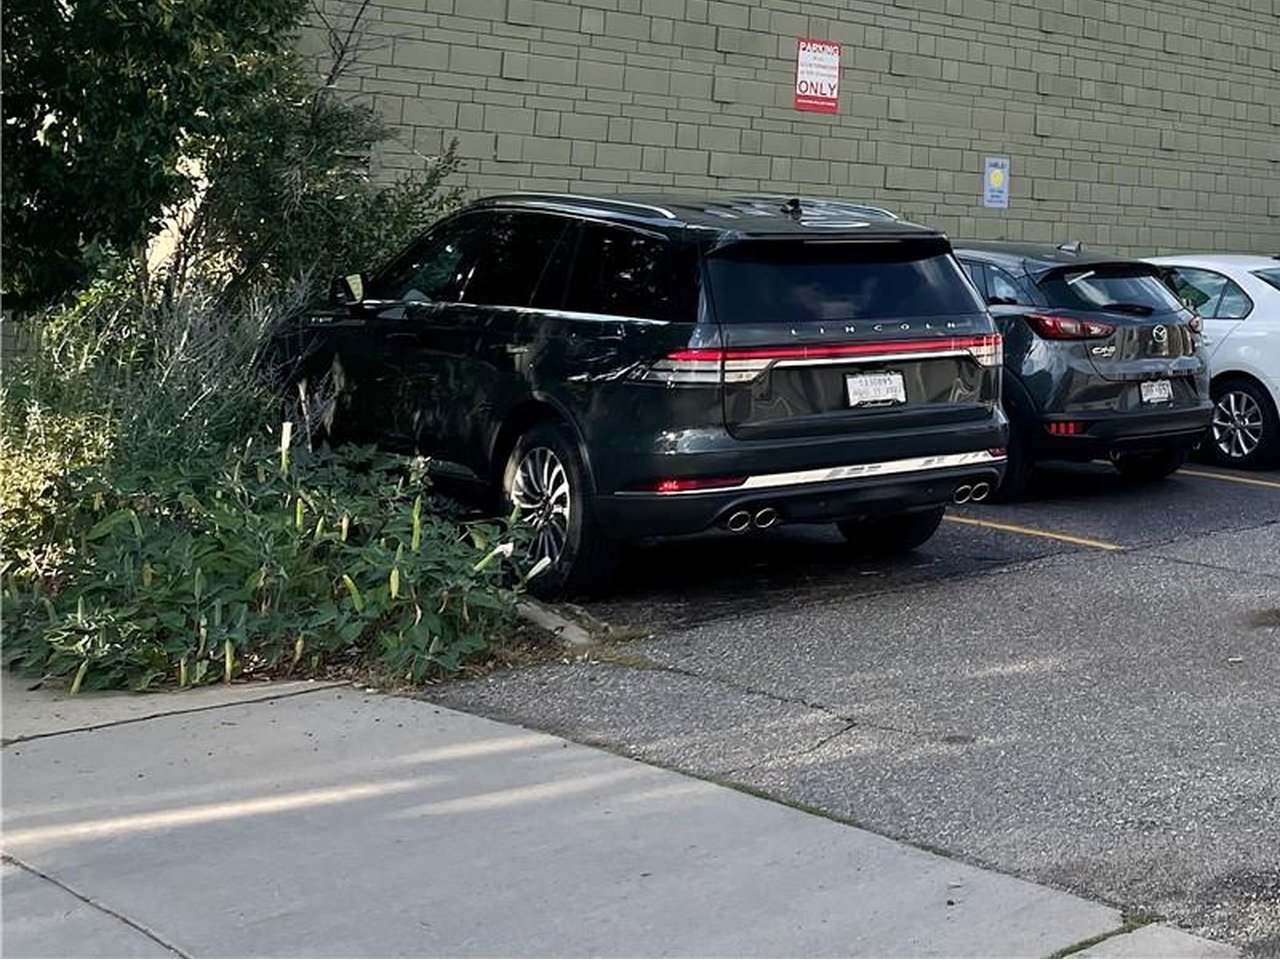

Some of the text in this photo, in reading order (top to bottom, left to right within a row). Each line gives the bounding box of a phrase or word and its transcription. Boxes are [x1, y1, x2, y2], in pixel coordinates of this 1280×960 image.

[800, 41, 840, 55] PARKING
[799, 80, 837, 96] ONLY
[791, 321, 957, 336] LINCOLN
